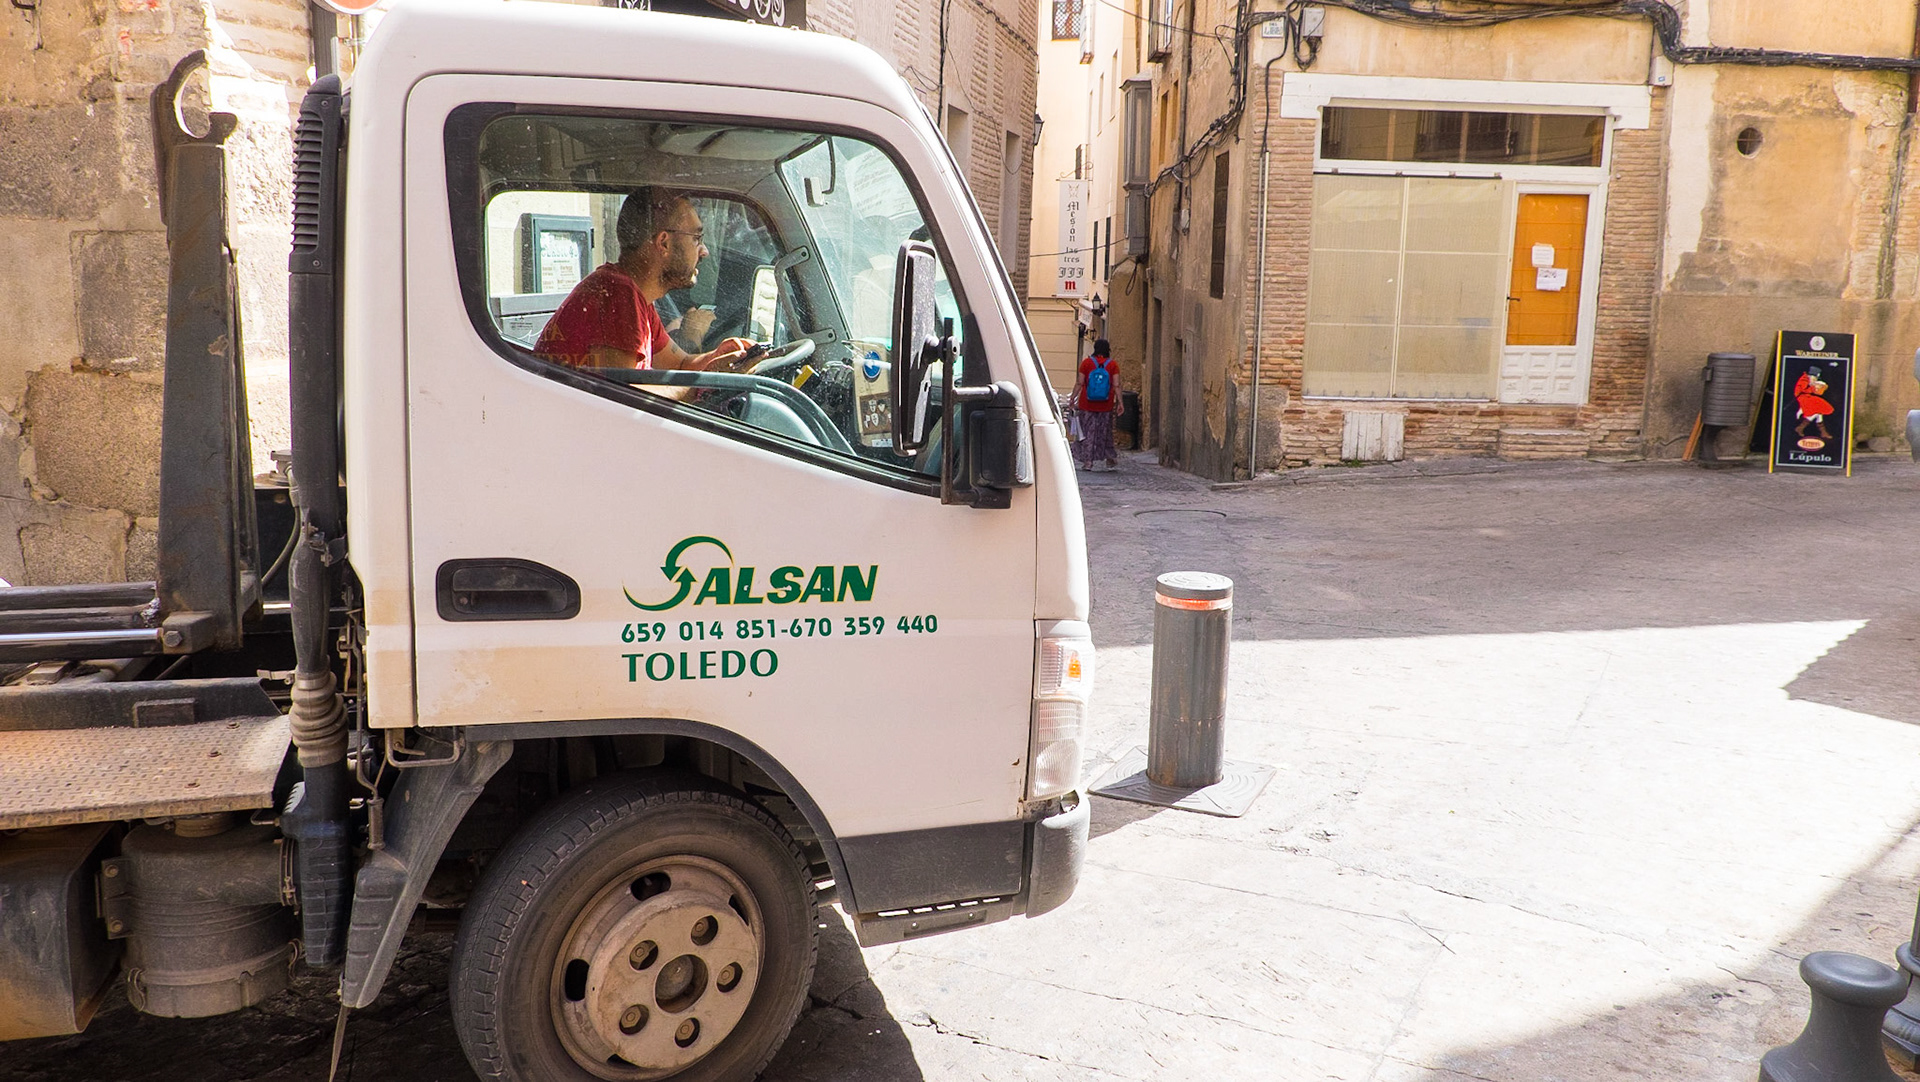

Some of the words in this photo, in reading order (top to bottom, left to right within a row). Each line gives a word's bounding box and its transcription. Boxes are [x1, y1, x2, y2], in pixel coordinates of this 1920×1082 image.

[1789, 452, 1832, 463] Lúpulo
[621, 622, 666, 643] 659
[679, 621, 724, 641] 014
[736, 617, 832, 639] 851-670
[844, 616, 885, 636] 359
[897, 614, 938, 634] 440
[622, 649, 779, 682] TOLEDO
